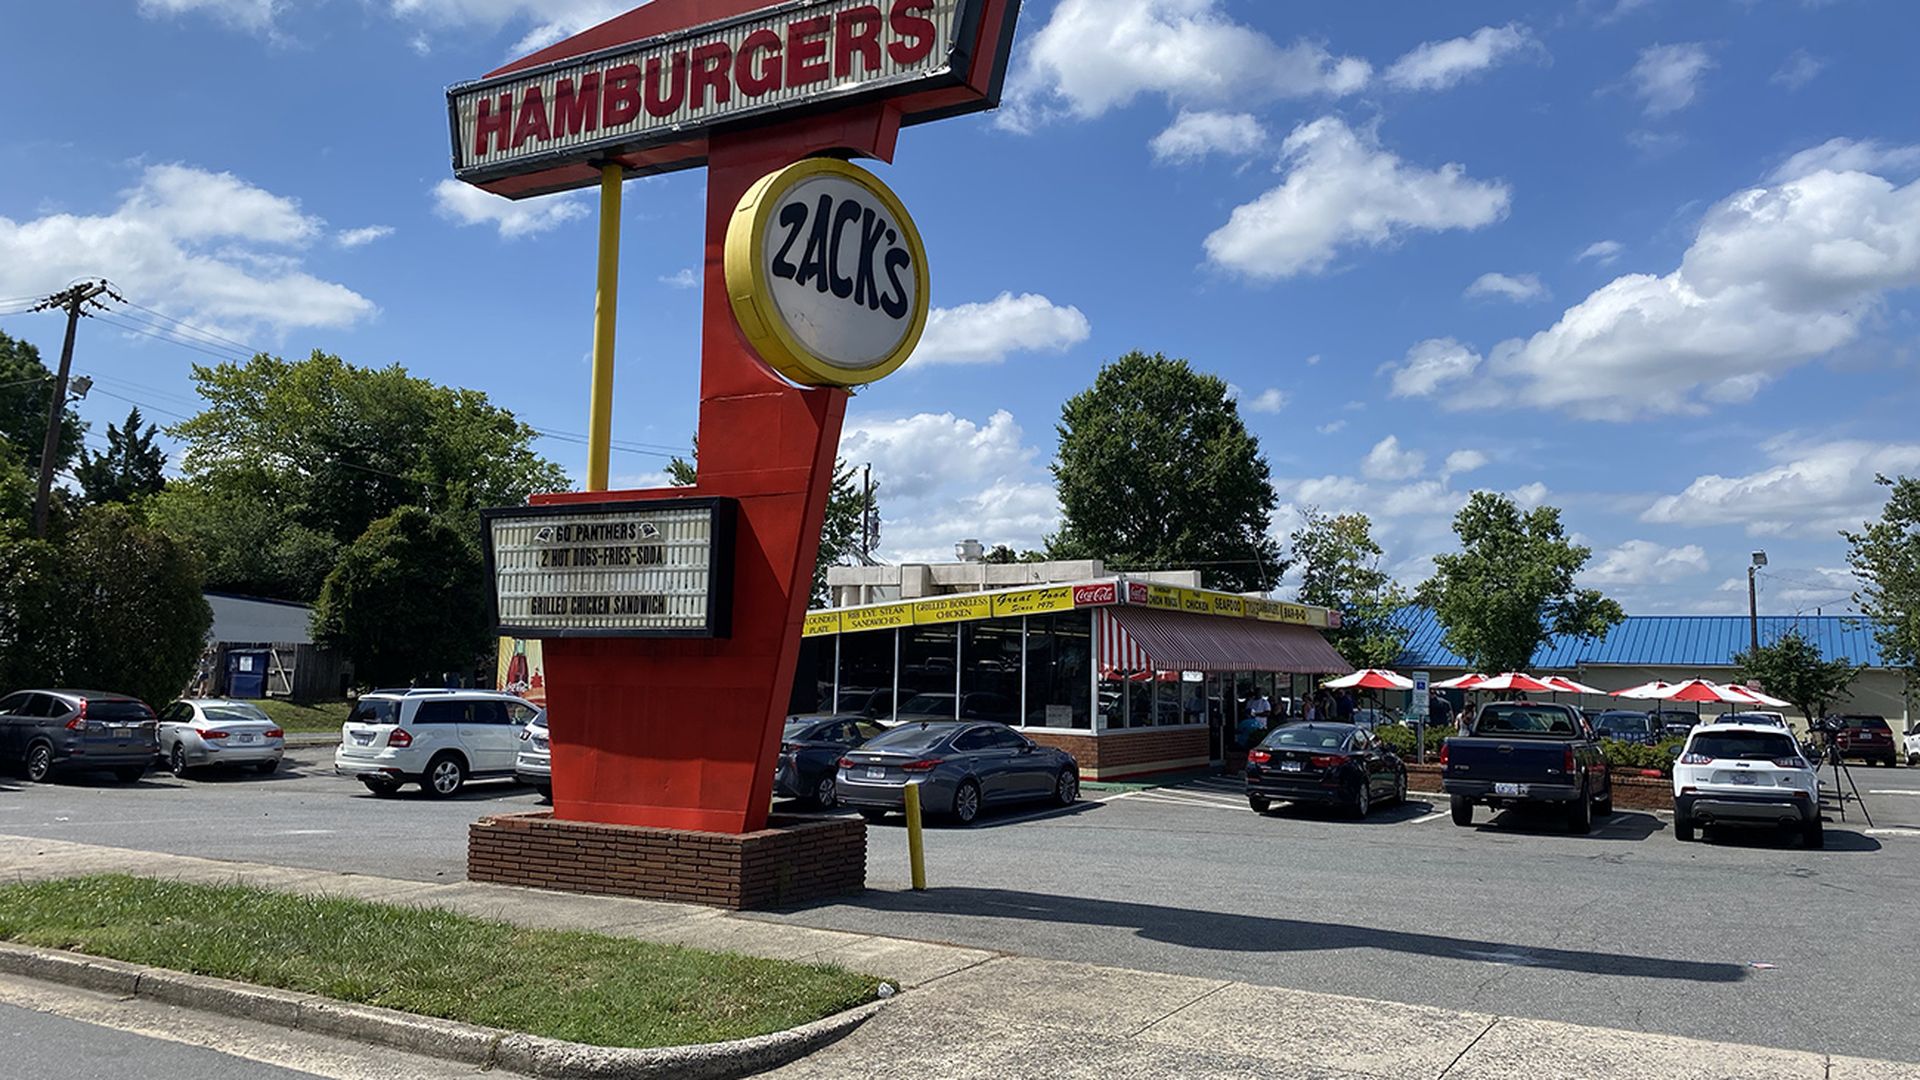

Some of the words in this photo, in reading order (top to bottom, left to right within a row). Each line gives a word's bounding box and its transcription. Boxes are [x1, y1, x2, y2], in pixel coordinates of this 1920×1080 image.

[475, 0, 936, 156] HAMBURGERS
[771, 194, 910, 320] ZACK'S
[556, 525, 571, 542] GO
[575, 523, 636, 541] PANTHERS
[541, 550, 549, 567] 2
[551, 548, 569, 567] HOT
[530, 596, 568, 615] GRILLED
[570, 596, 611, 615] CHICKEN
[613, 595, 666, 615] SANDWICH
[997, 593, 1032, 607] Great
[1038, 588, 1068, 601] Food
[935, 608, 972, 620] CHICKEN
